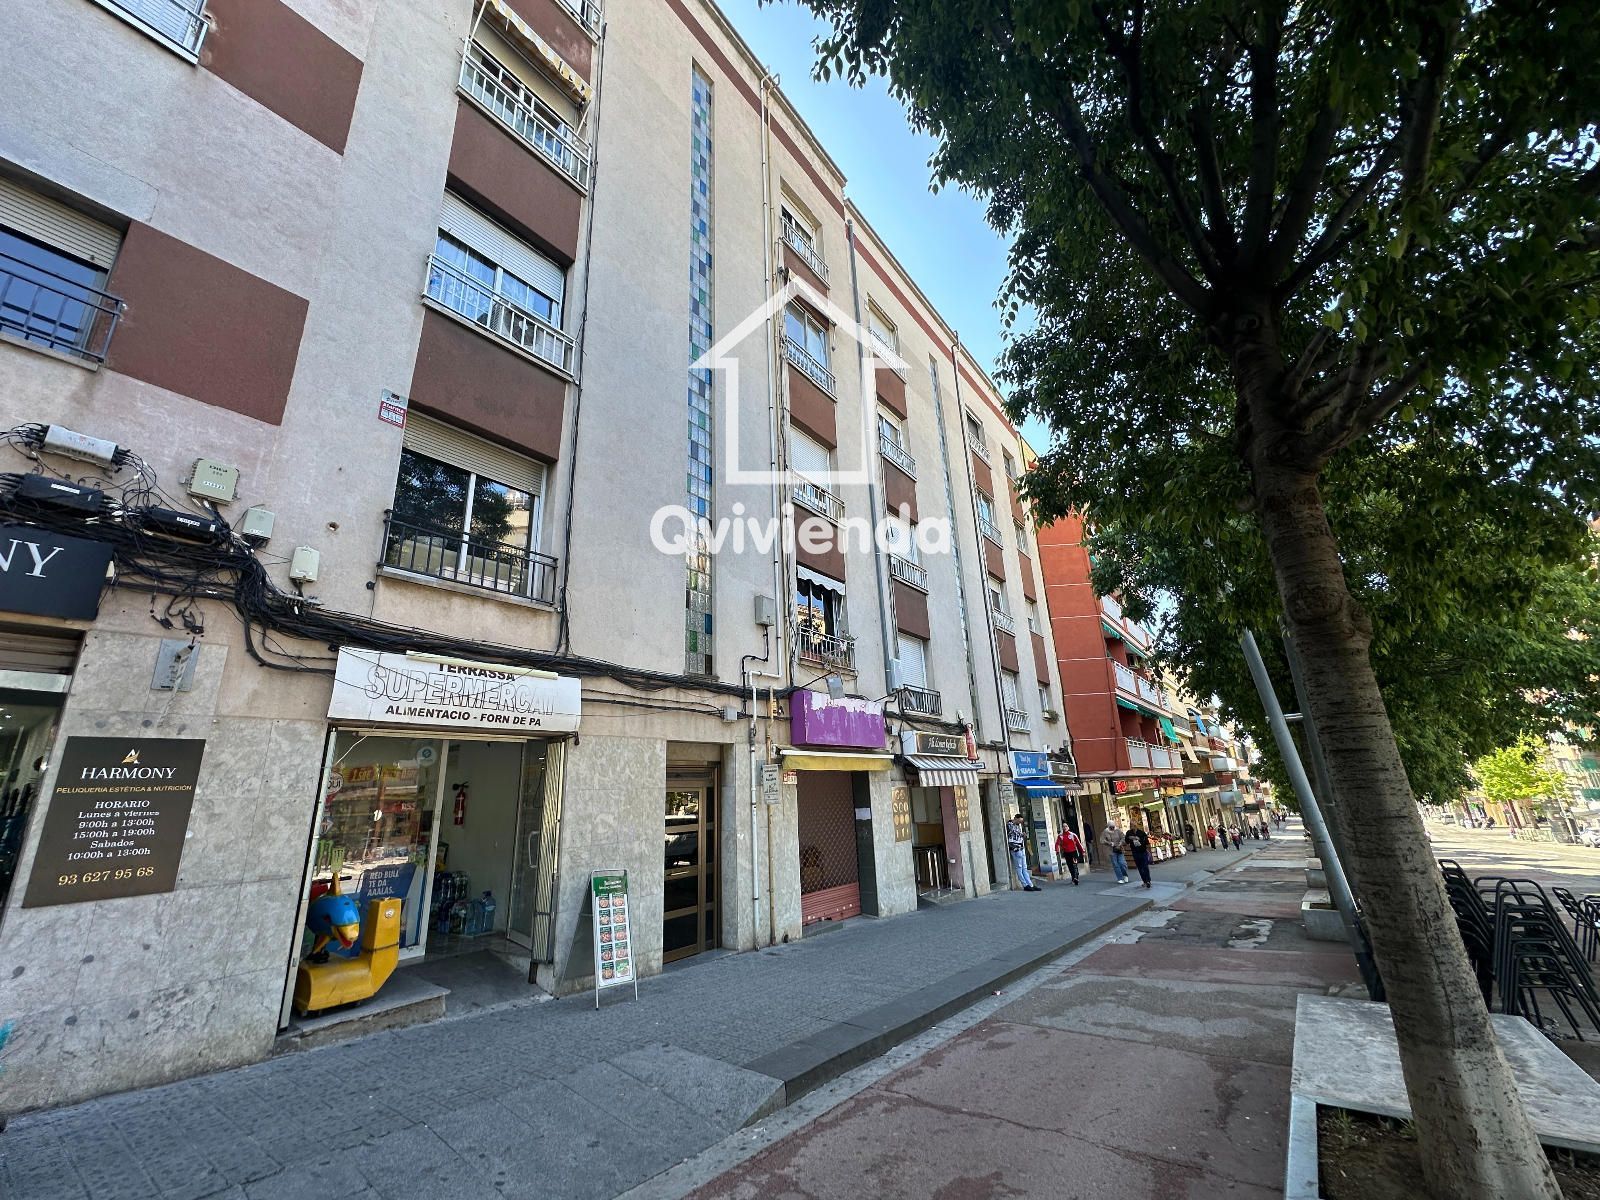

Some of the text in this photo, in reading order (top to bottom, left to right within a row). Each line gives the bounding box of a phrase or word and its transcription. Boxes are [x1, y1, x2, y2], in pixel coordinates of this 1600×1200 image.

[364, 665, 556, 716] SUPERMERCAT
[385, 705, 471, 721] ALIMENTACIO
[480, 713, 510, 725] FORN
[512, 716, 527, 725] DE
[529, 717, 542, 727] PA
[80, 767, 177, 780] HARMONY
[94, 800, 150, 809] HORARIO
[78, 811, 112, 819] Lunes
[78, 820, 108, 829] 9:00h
[121, 818, 155, 827] 13:00h
[72, 829, 109, 840] 15:00h
[121, 828, 155, 837] 19:00h
[90, 839, 134, 849] Sabados
[67, 849, 104, 861] 10:00h
[116, 847, 151, 857] 13:00h
[58, 866, 155, 886] 93 627 95 68
[368, 880, 376, 888] TE
